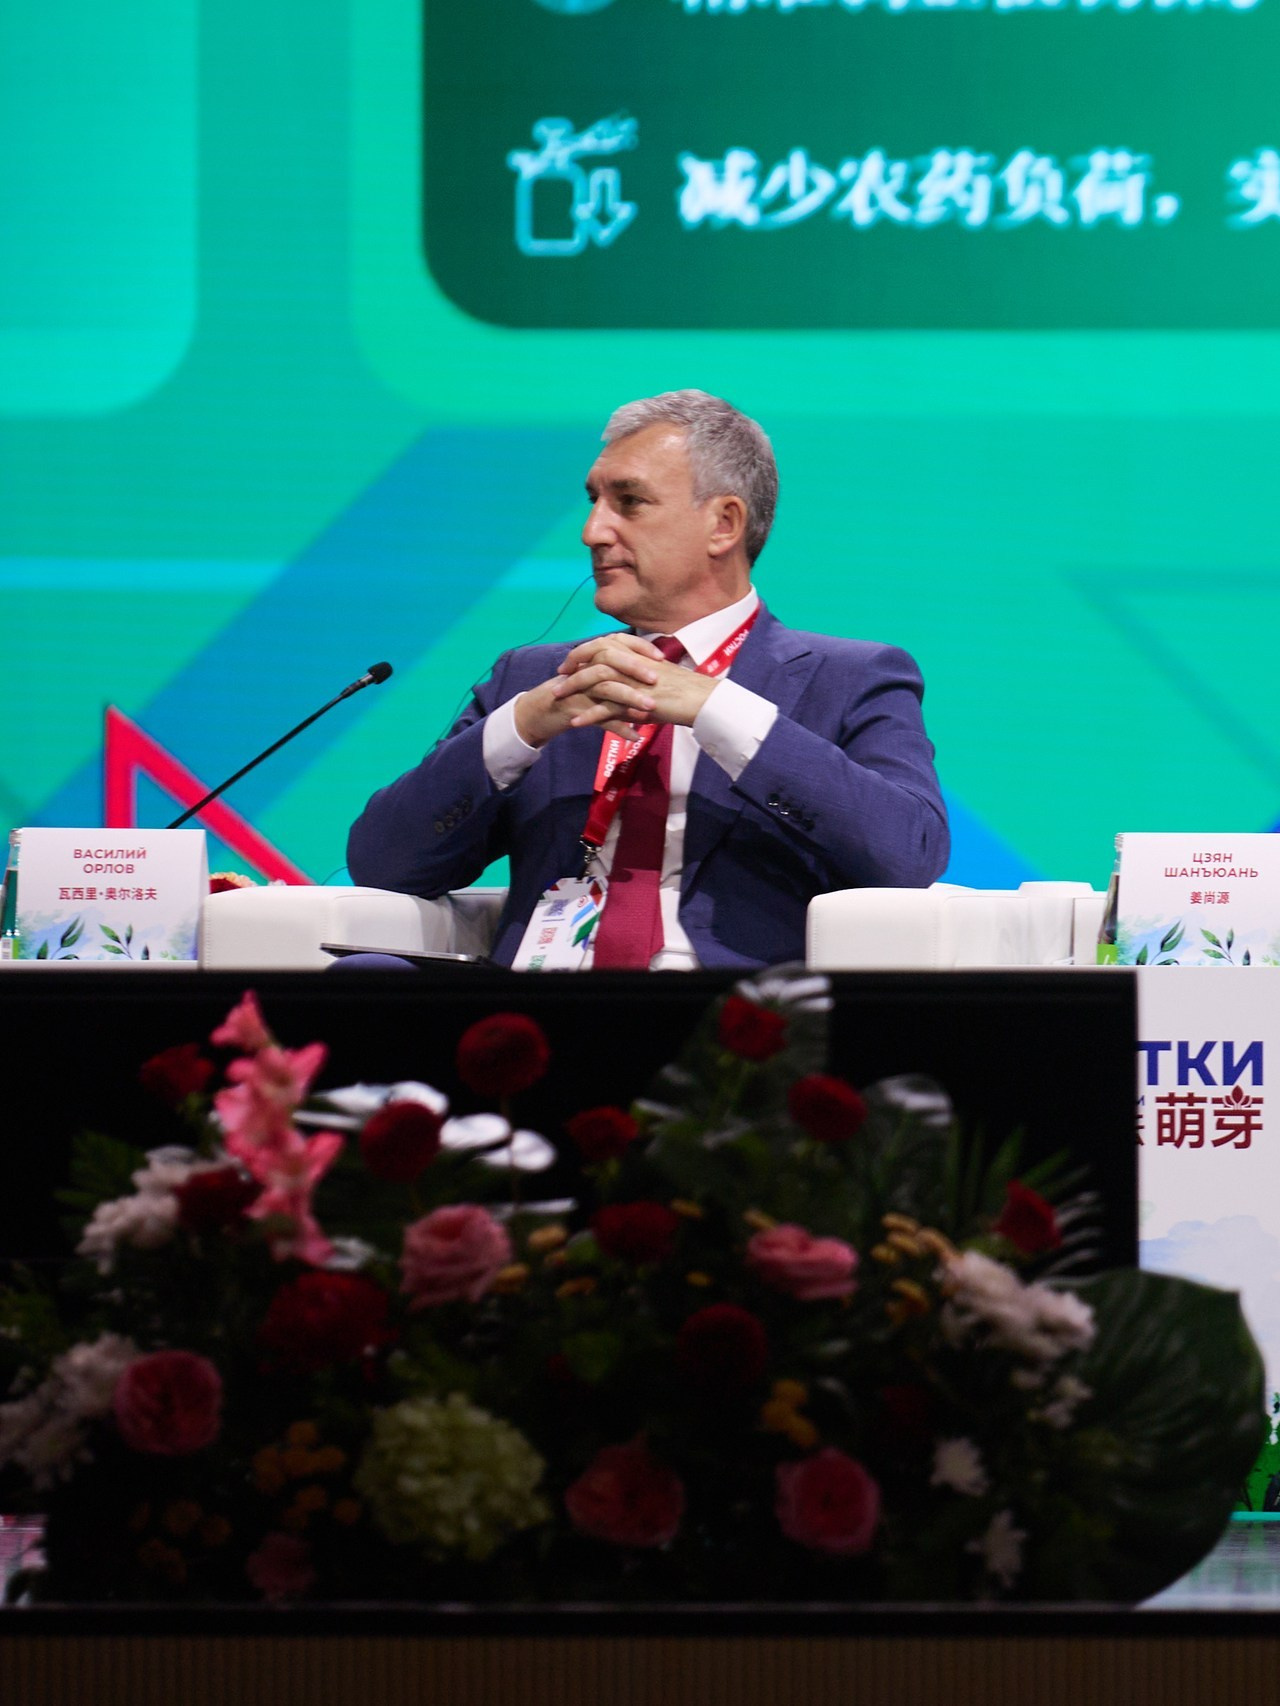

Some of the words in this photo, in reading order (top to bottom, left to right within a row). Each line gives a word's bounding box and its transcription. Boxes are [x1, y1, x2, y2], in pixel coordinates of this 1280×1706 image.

[73, 846, 147, 860] ВАСИЛИЙ
[1193, 853, 1233, 864] ЦЗЯН
[83, 863, 135, 875] ОРЛОВ
[1164, 867, 1259, 878] ШАНЪЮАНЬ
[1154, 1084, 1264, 1150] 萌芽
